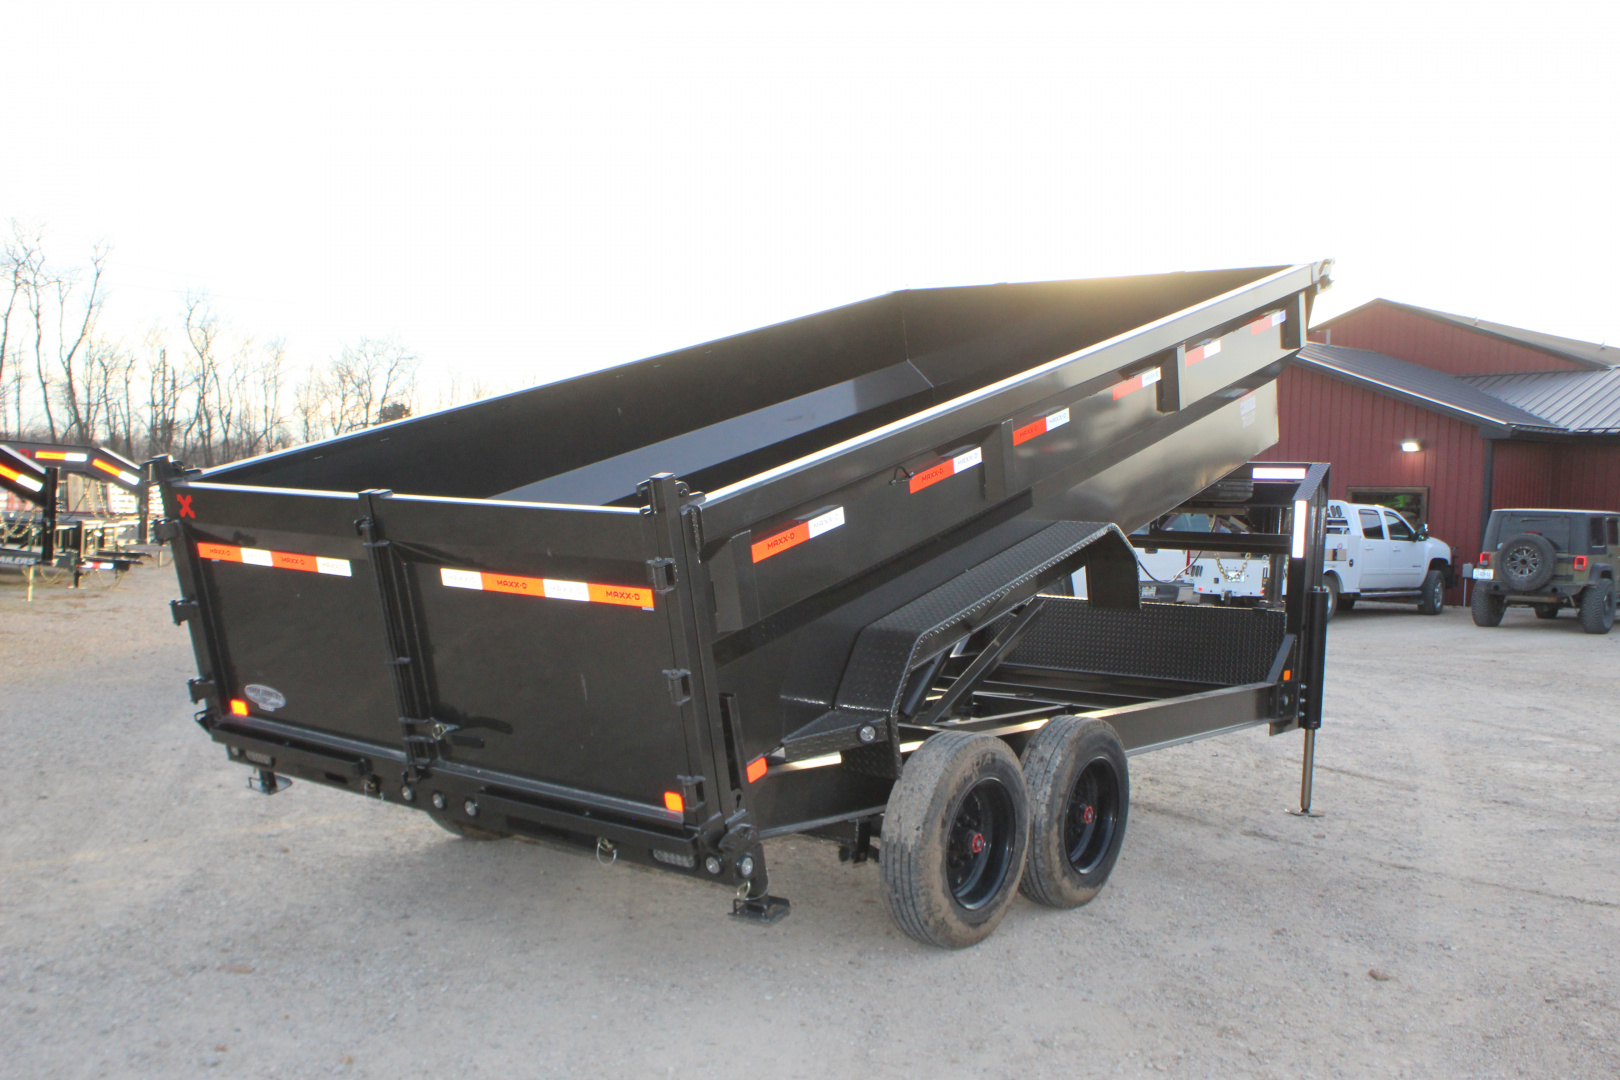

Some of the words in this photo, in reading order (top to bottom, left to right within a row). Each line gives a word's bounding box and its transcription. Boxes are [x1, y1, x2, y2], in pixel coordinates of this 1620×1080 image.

[921, 468, 944, 482] MAXX-D
[176, 494, 196, 519] X
[767, 532, 795, 550] MAXX-D
[209, 548, 231, 557] MAXX-D
[281, 557, 305, 566] MAXX-D
[496, 579, 528, 590] MAXX-D
[605, 590, 640, 601] MAXX-D
